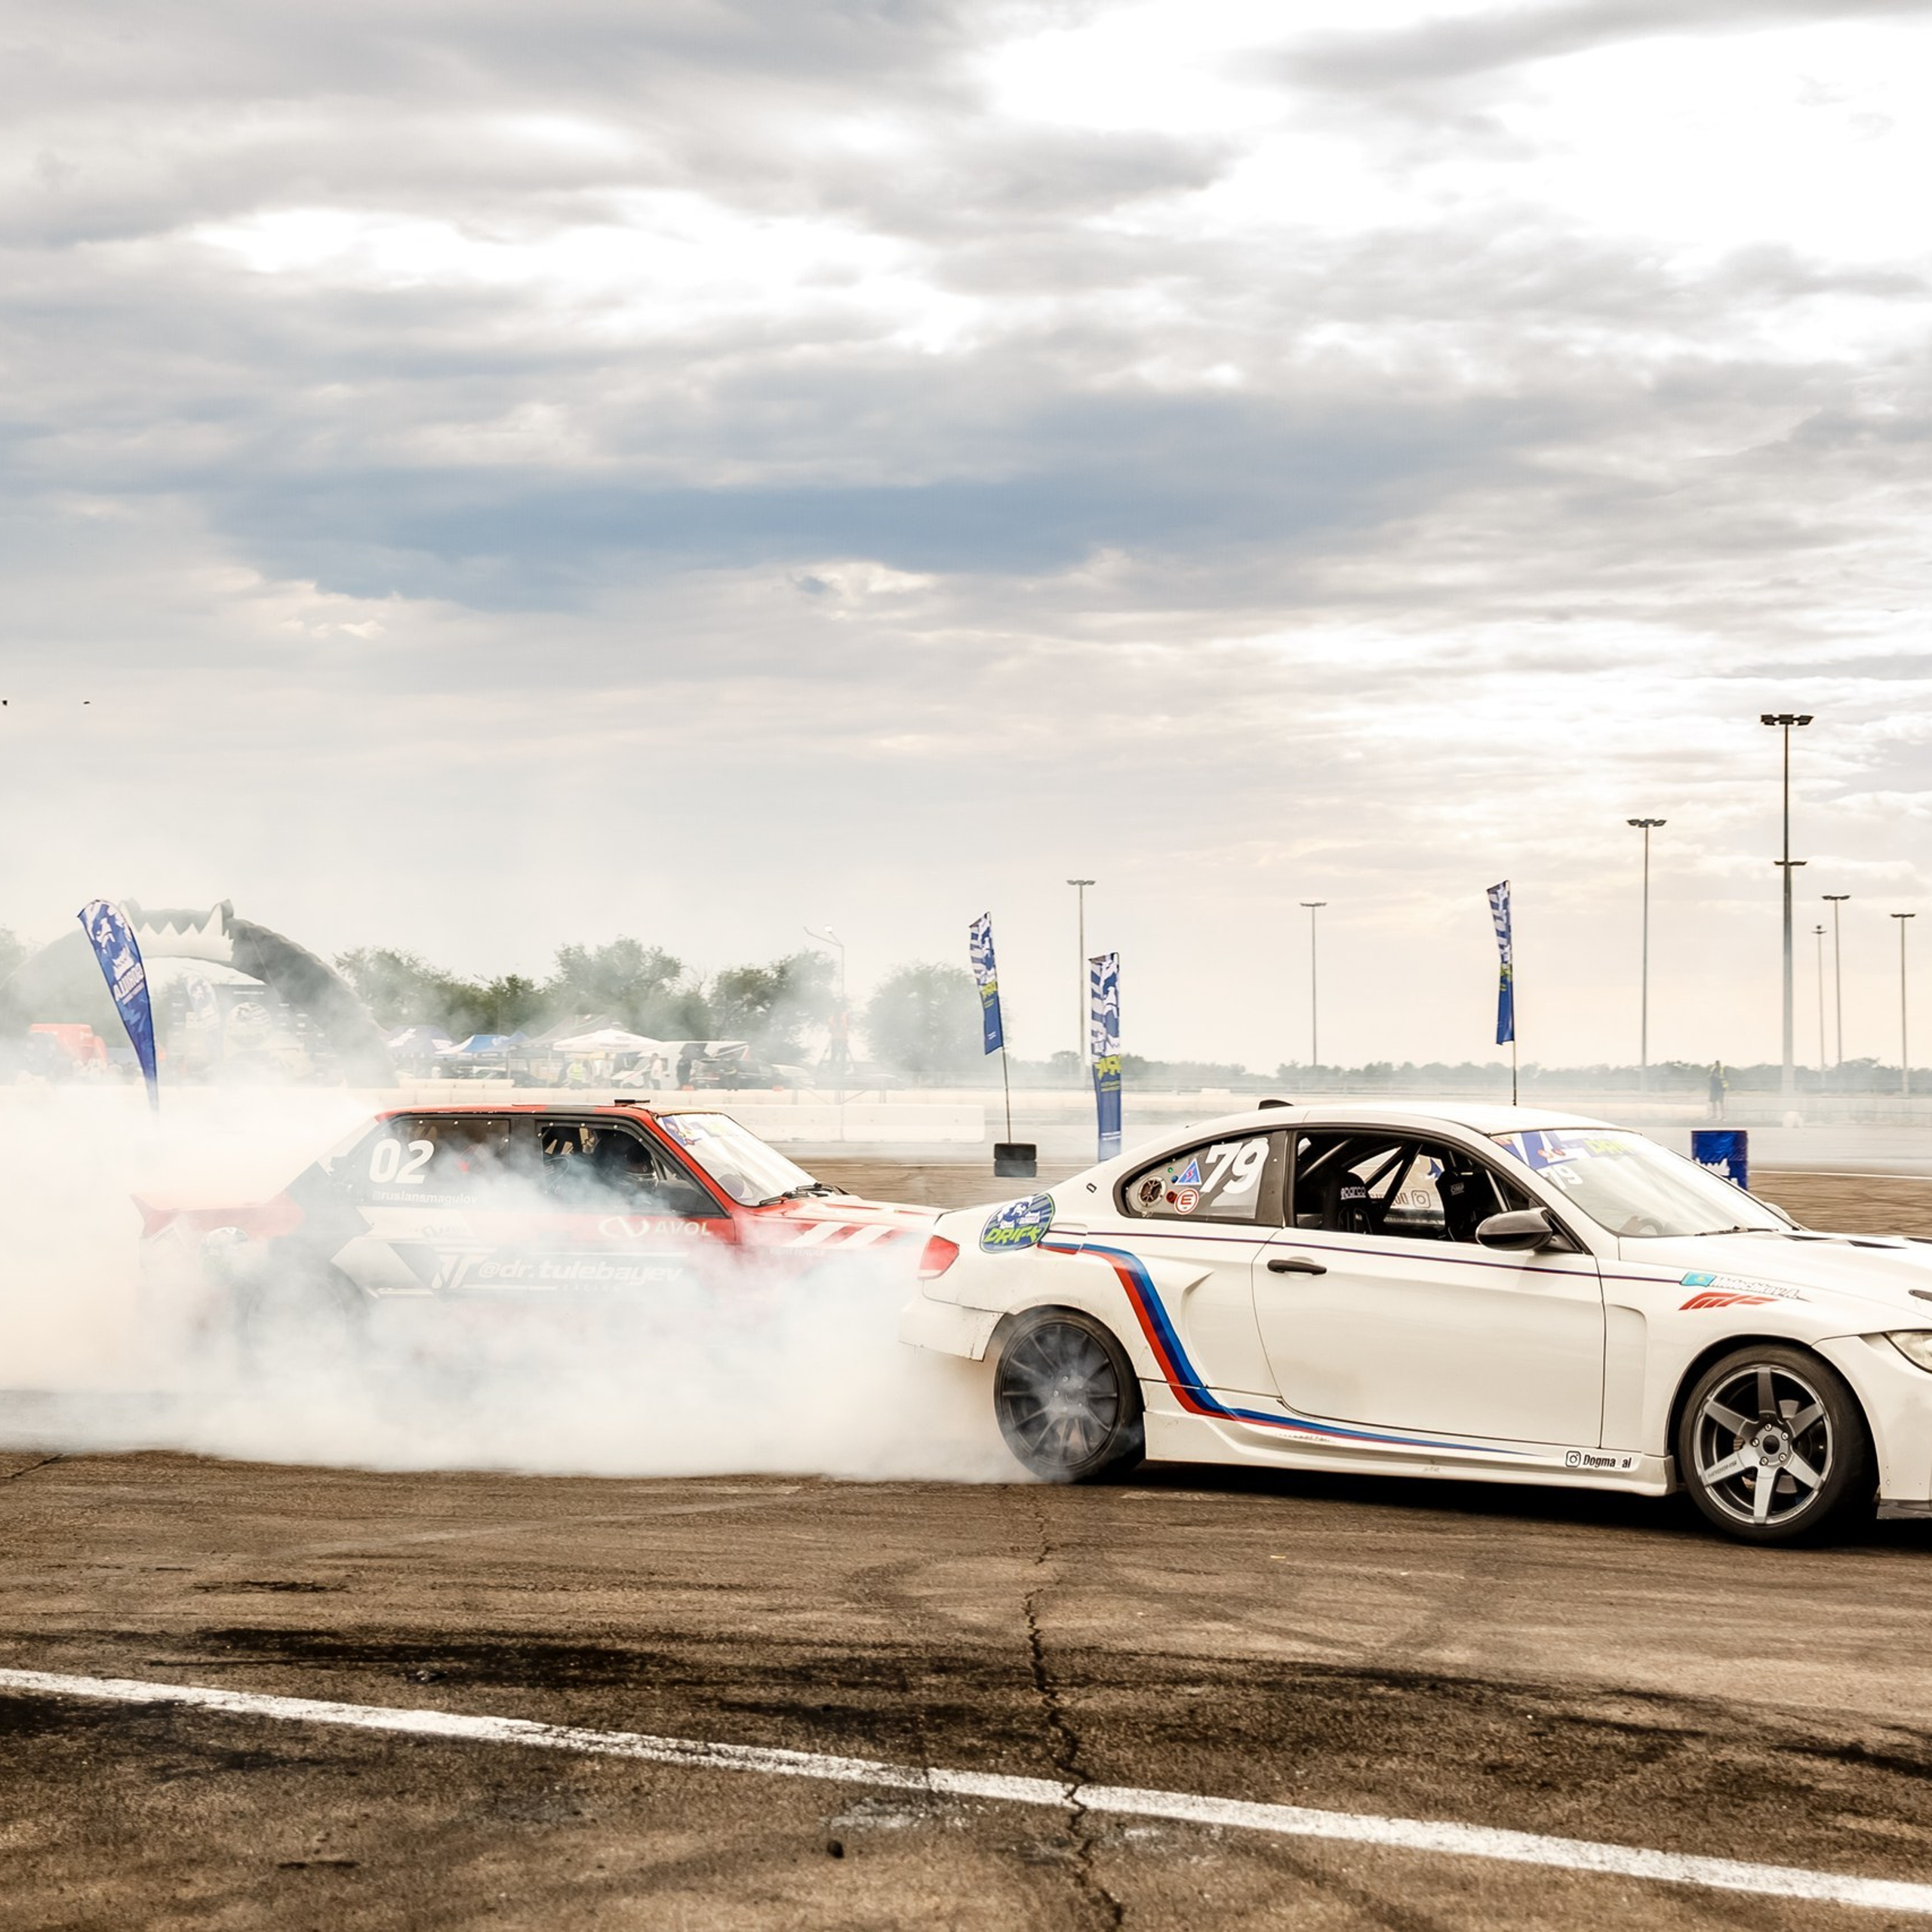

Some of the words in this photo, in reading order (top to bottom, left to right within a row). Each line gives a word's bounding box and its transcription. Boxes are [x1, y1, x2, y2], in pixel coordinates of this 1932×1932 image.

[369, 1138, 435, 1184] 02
[1199, 1137, 1270, 1194] 79
[1536, 1164, 1583, 1190] 79
[983, 1225, 1041, 1244] DRIFT
[478, 1258, 684, 1285] @dr.tulebayev
